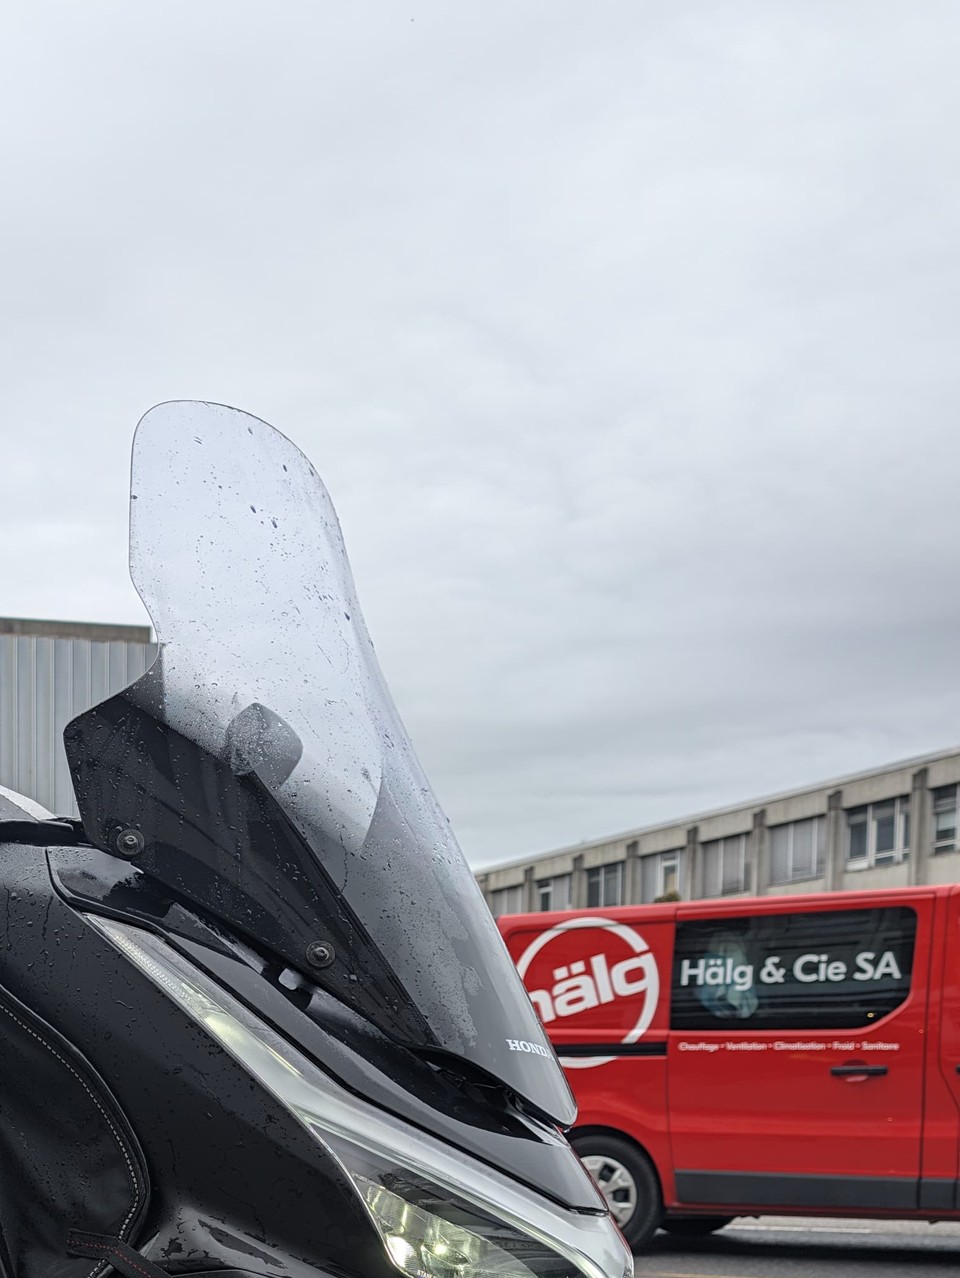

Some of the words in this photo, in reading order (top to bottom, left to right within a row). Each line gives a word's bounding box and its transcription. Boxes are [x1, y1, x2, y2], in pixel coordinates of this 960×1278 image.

[680, 958, 753, 991] Hälg
[759, 956, 786, 984] &
[793, 953, 847, 982] Cie
[853, 951, 902, 981] SA
